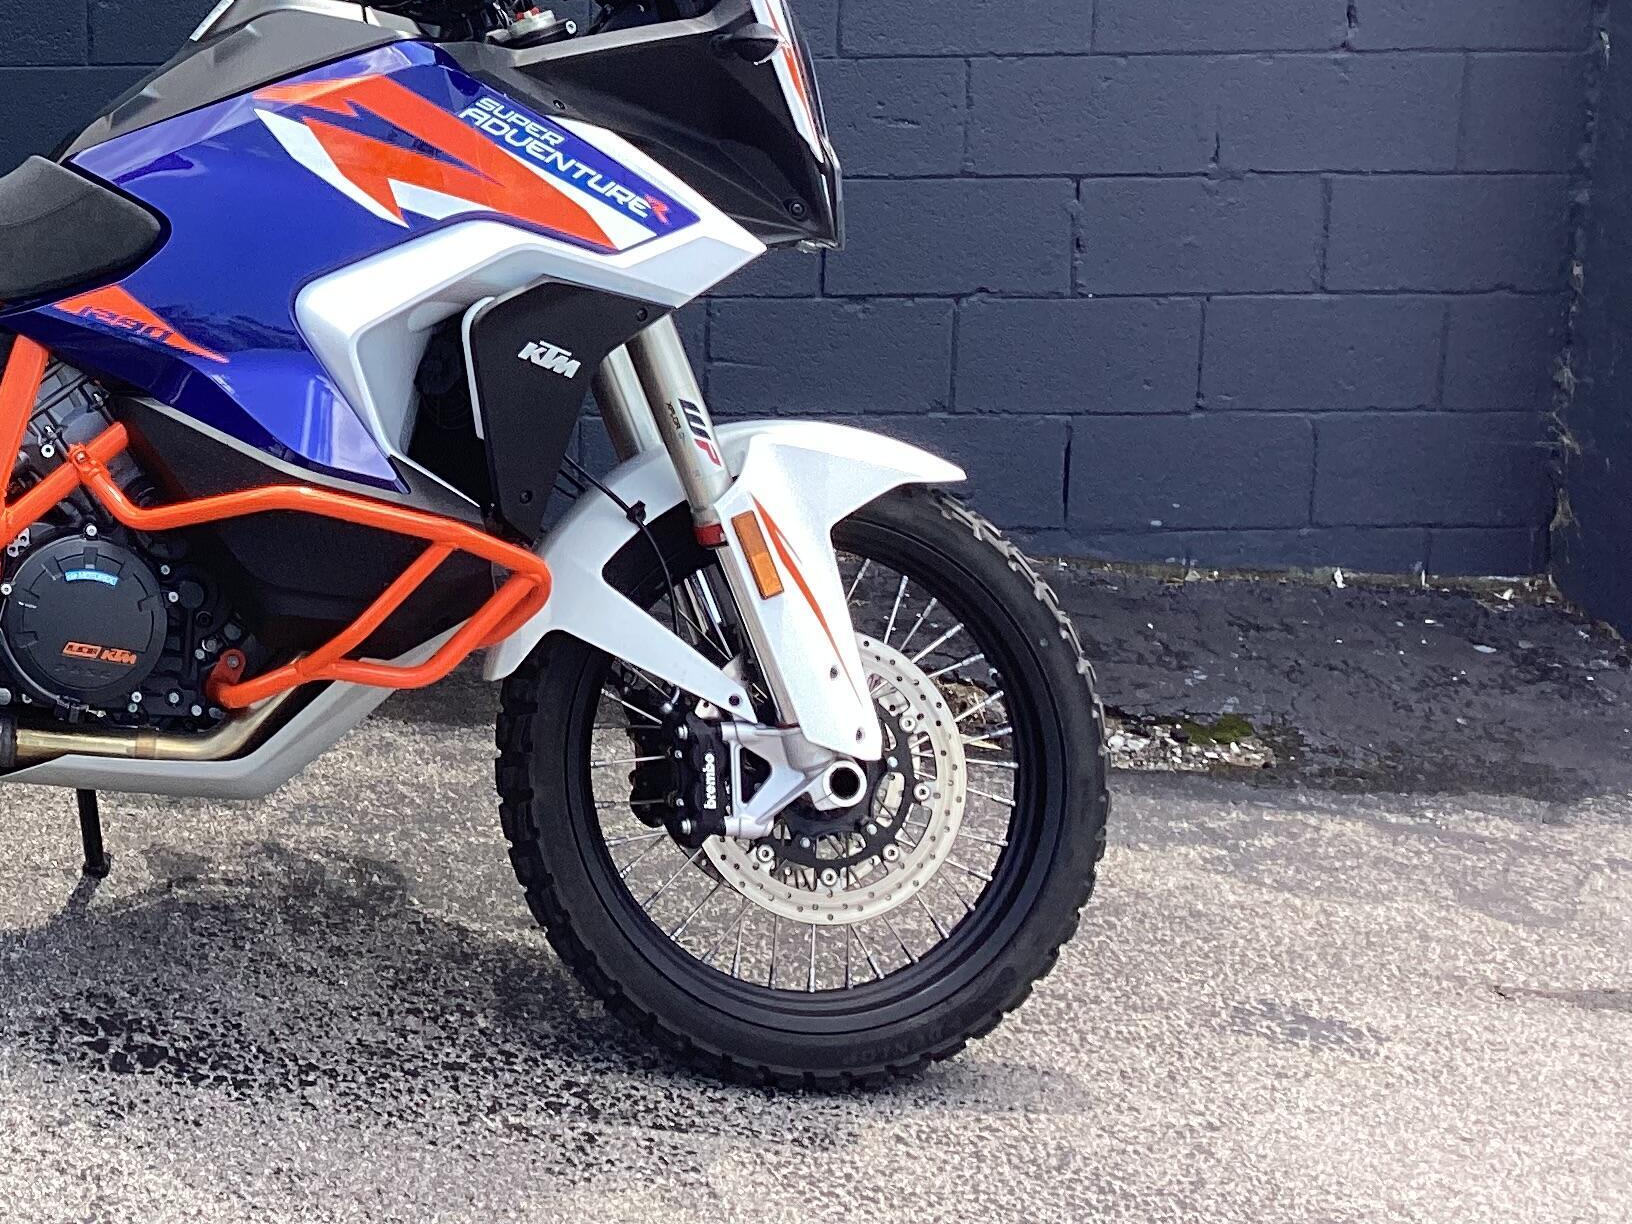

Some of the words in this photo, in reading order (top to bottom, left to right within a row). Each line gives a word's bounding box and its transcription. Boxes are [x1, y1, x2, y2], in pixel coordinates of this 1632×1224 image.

[475, 97, 565, 146] SUPER
[518, 340, 581, 378] KTM
[100, 648, 137, 665] KTM
[702, 753, 717, 810] brembo
